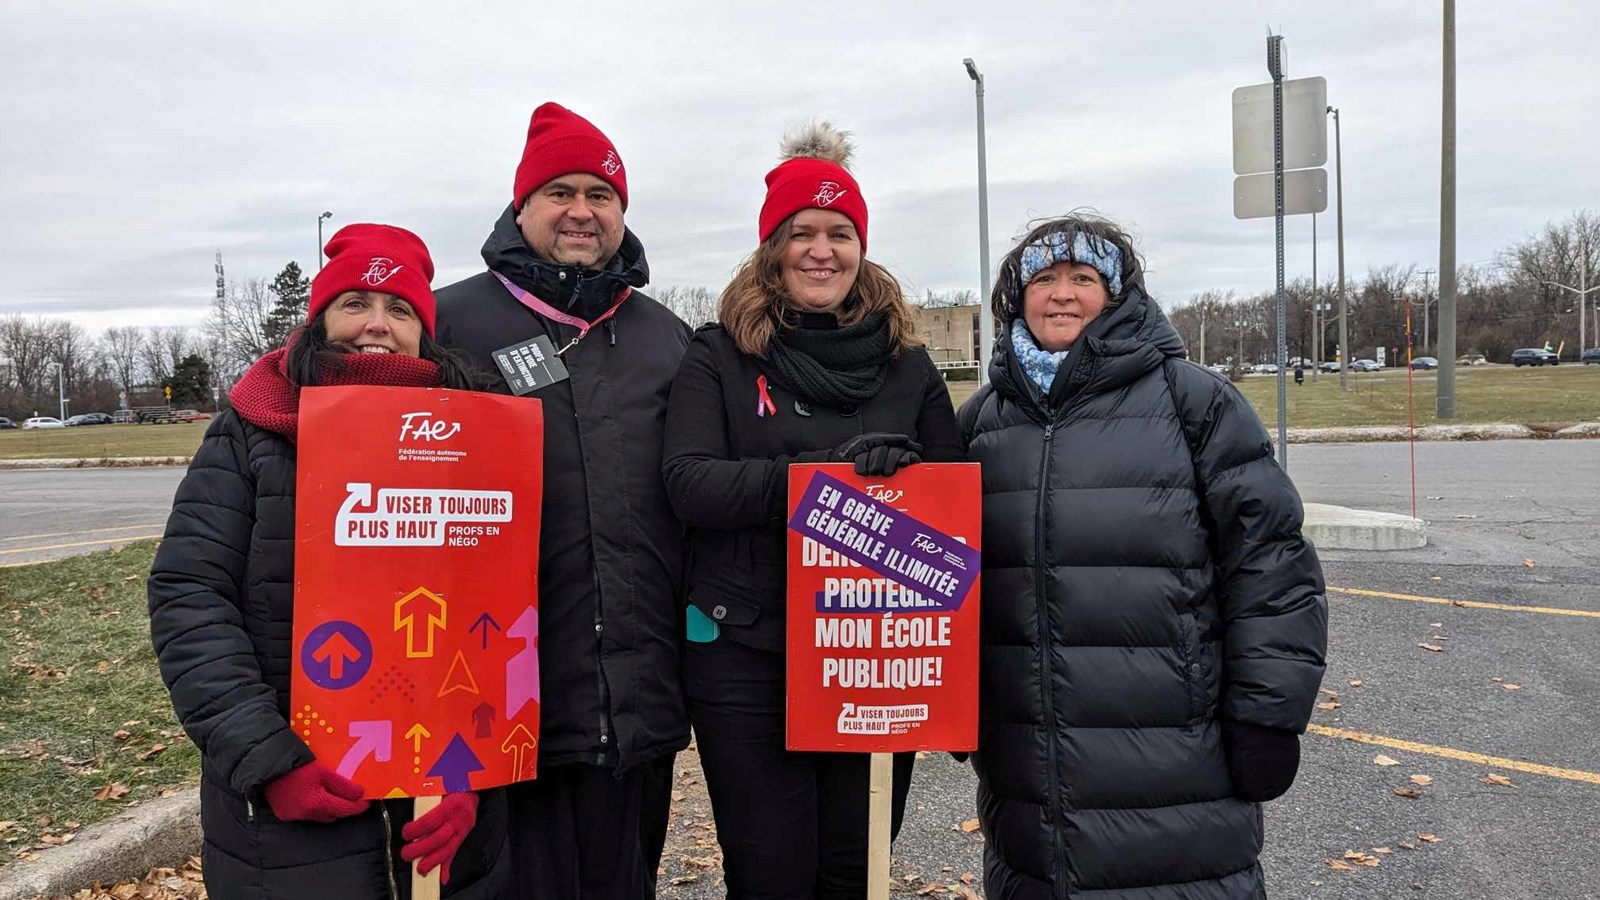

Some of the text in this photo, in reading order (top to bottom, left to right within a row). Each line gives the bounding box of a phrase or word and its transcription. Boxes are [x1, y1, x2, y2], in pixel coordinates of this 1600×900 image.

[528, 342, 545, 362] PROFS
[385, 495, 507, 515] VISER TOUJOURS
[817, 484, 895, 537] EN GRÈVE
[348, 520, 438, 539] PLUS HAUT
[449, 526, 500, 536] PROFS EN
[448, 536, 479, 546] NÉGO
[806, 508, 886, 561] GÉNÉRALE
[883, 547, 960, 598] ILLIMITÉE
[815, 611, 951, 648] MON ÉCOLE
[822, 656, 943, 690] PUBLIQUE!
[861, 708, 925, 719] VISER TOUJOURS
[843, 721, 886, 731] PLUS HAUT
